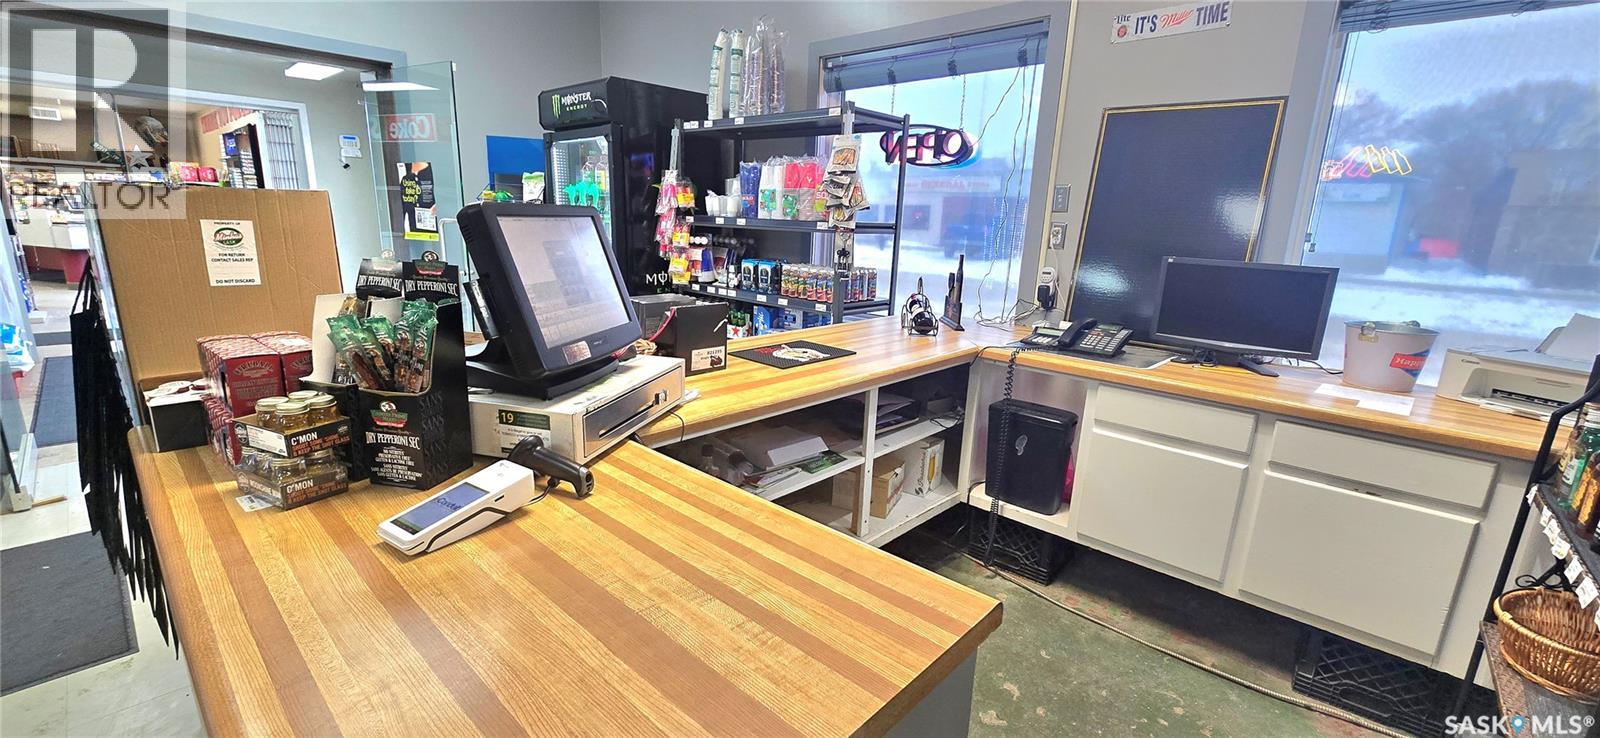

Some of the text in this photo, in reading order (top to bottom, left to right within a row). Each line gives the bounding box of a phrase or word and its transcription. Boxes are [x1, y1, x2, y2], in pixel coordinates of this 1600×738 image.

[1135, 1, 1231, 35] IT'S Miller TIME
[368, 275, 393, 288] PEPPERONI
[393, 278, 402, 291] SEC
[405, 279, 458, 296] DRY PEPPERONI SEC
[501, 411, 514, 424] 19
[290, 431, 318, 446] C'MON
[365, 431, 421, 450] DRY PEPPERONI SEC
